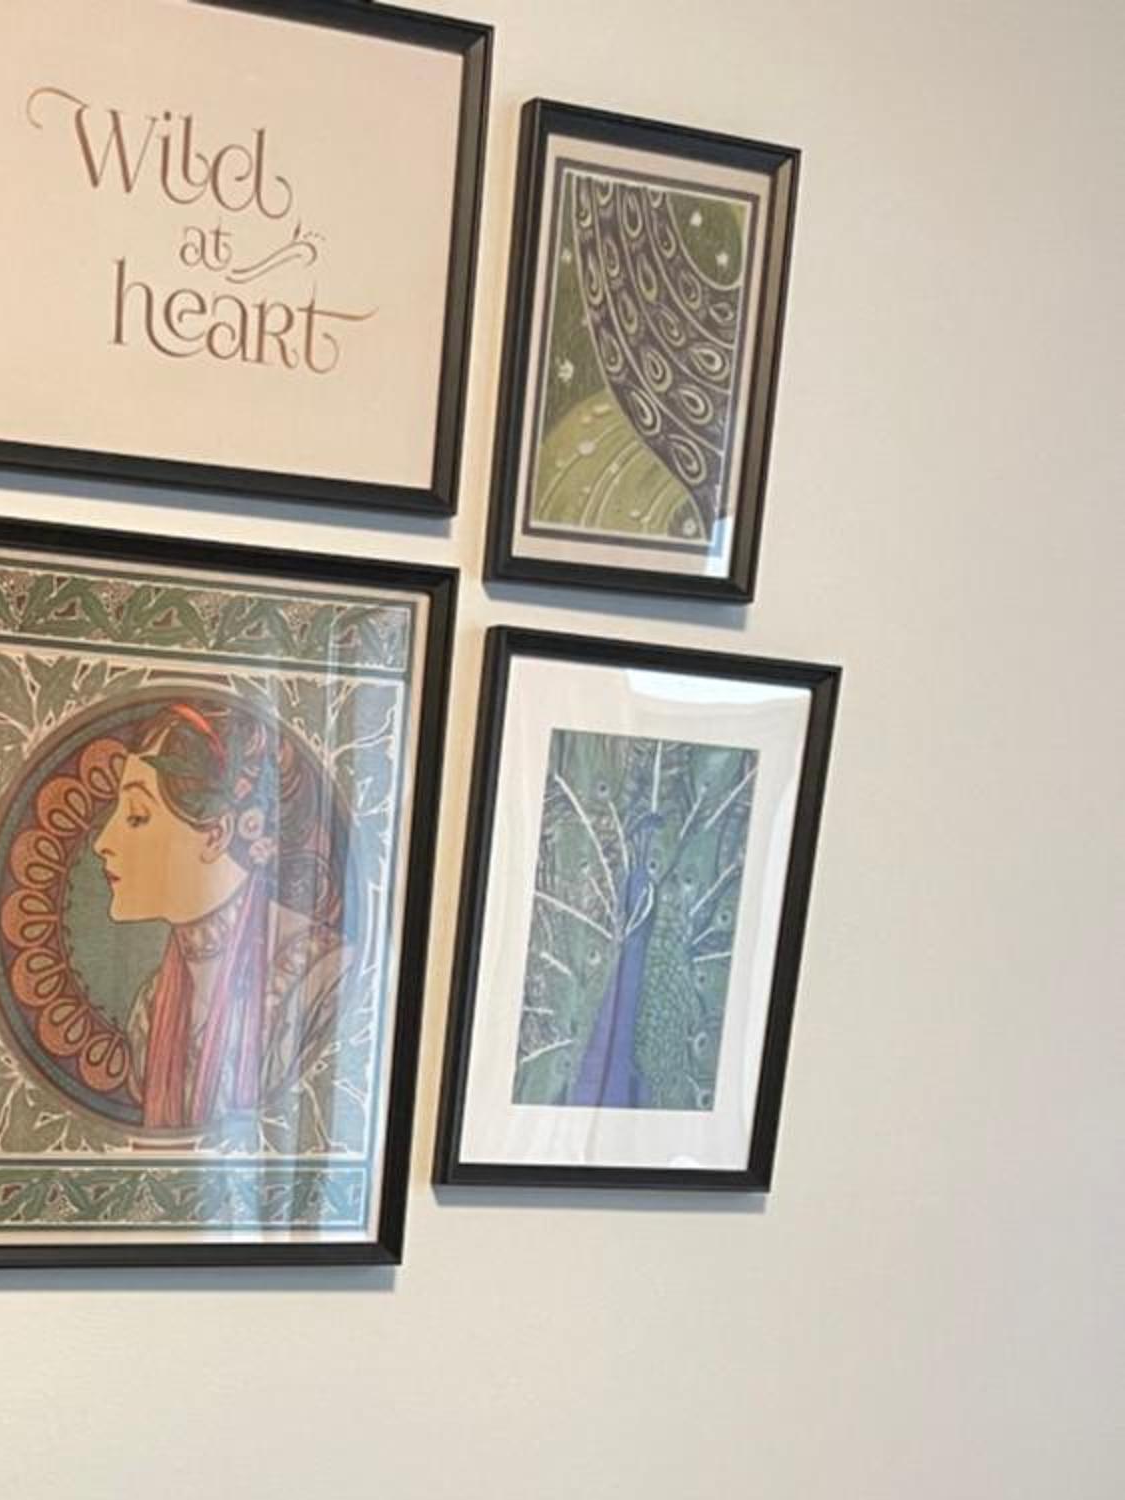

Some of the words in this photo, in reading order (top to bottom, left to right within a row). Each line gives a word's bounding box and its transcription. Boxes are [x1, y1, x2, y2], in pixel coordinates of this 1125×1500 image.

[27, 86, 292, 220] Wild
[179, 220, 233, 272] at
[111, 257, 377, 374] heart
